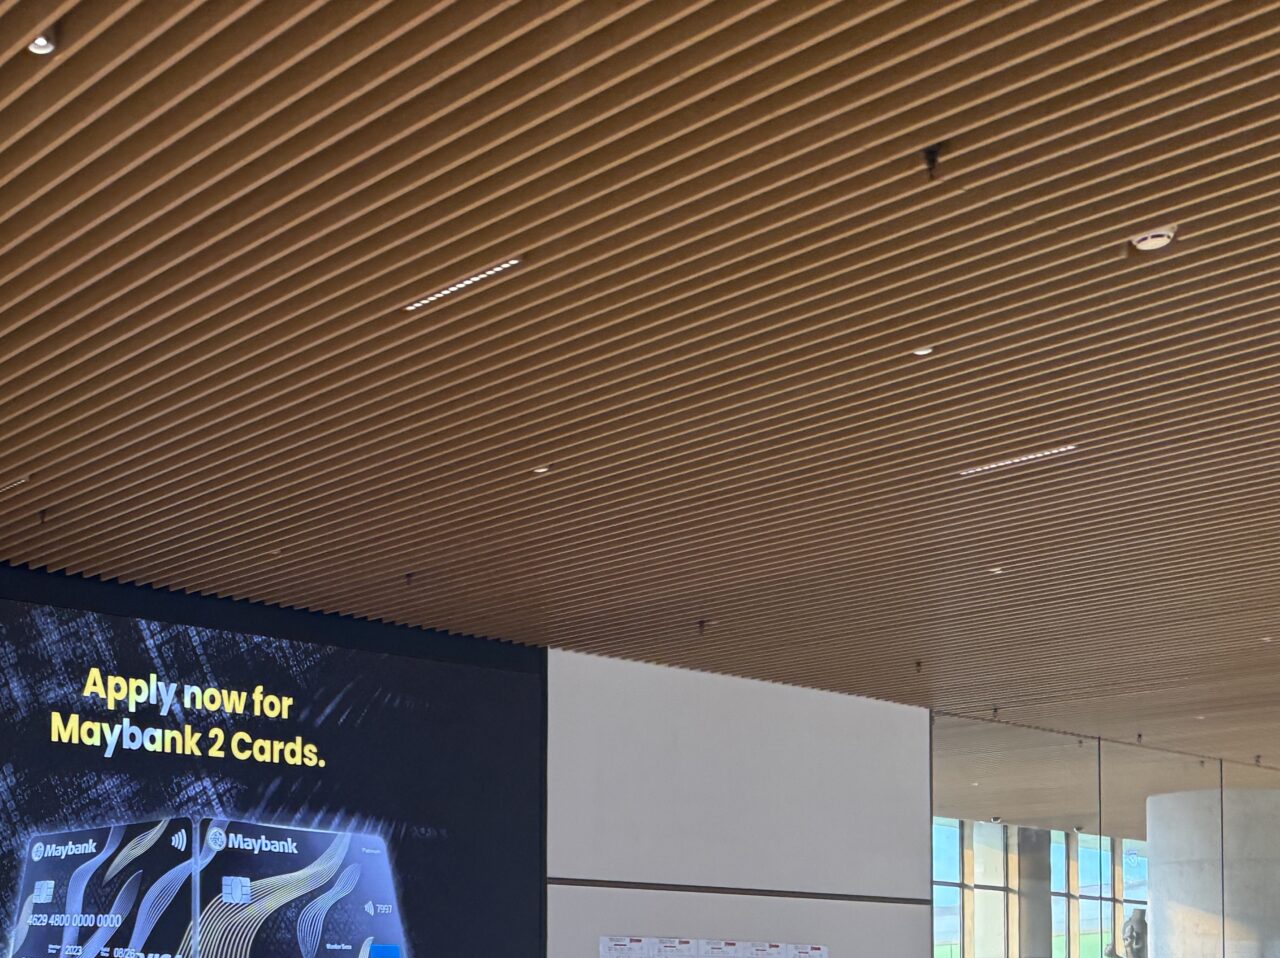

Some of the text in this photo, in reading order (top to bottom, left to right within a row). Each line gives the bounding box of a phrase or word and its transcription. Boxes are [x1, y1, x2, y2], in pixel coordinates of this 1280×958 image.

[82, 667, 294, 720] Apply now for
[50, 711, 326, 768] Maybank 2 Cards.
[44, 838, 97, 860] Maybank
[228, 833, 299, 855] Maybank
[27, 914, 122, 928] 4629 4800 0000 0000
[64, 945, 83, 956] 2023
